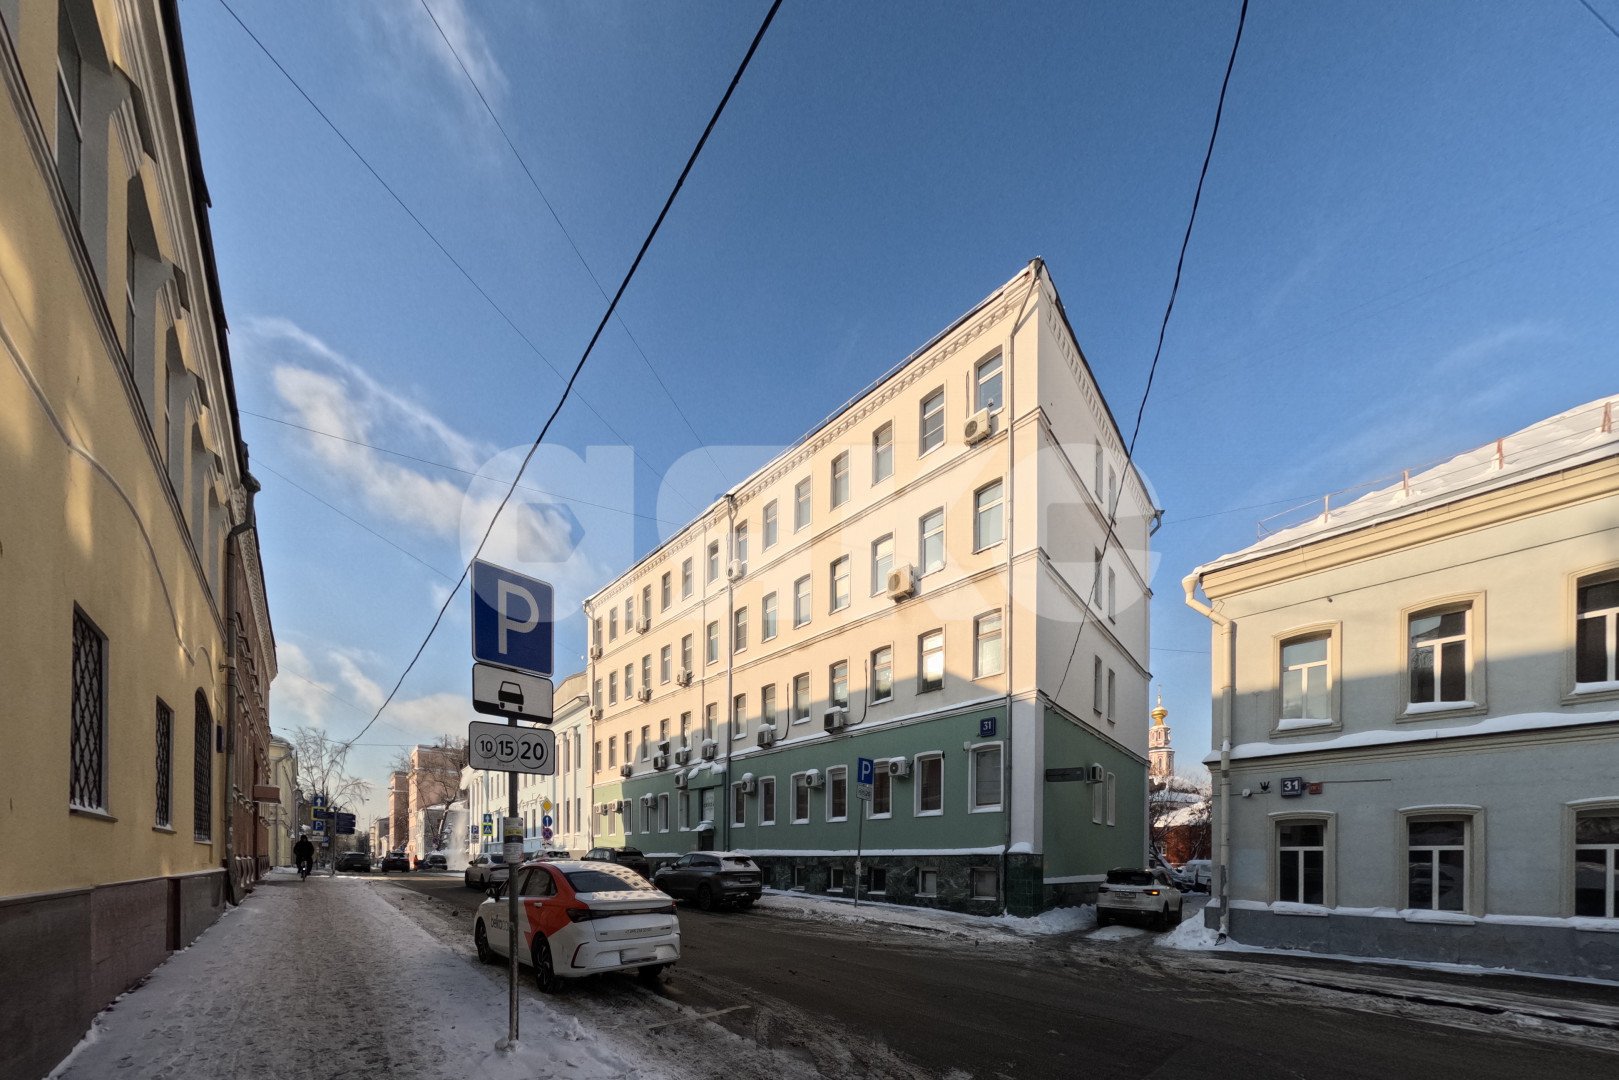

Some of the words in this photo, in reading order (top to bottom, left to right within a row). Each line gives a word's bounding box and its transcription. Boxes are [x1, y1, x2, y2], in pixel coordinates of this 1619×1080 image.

[498, 579, 540, 655] P
[983, 720, 992, 731] 31
[480, 739, 493, 753] 10
[498, 740, 514, 756] 15
[520, 741, 544, 761] 20
[861, 760, 871, 781] P
[1284, 780, 1299, 791] 31
